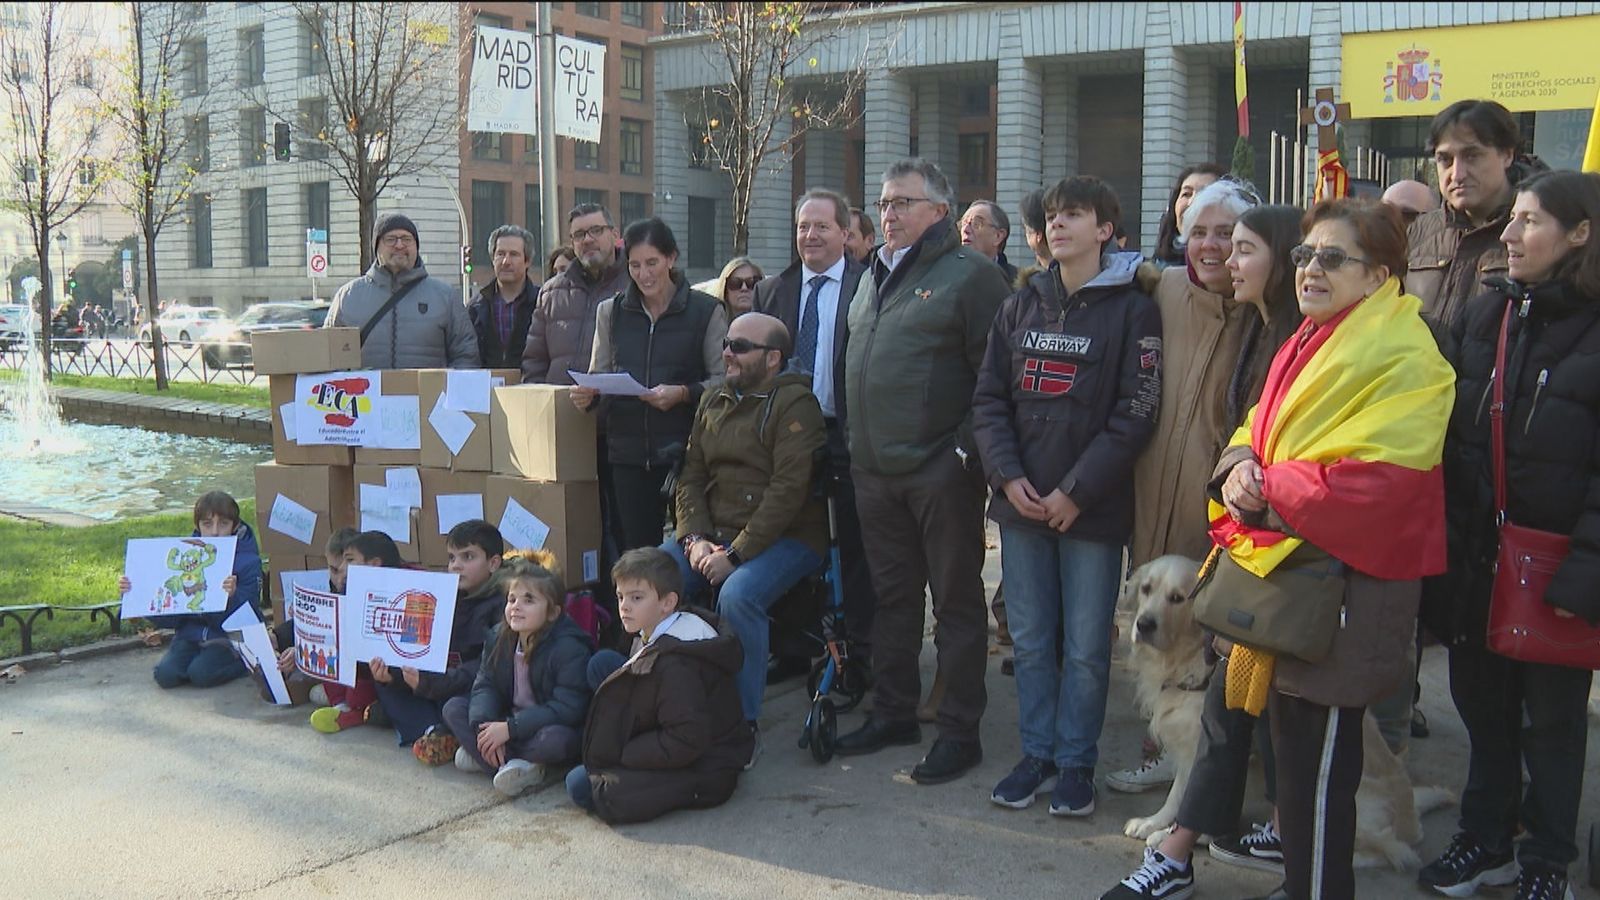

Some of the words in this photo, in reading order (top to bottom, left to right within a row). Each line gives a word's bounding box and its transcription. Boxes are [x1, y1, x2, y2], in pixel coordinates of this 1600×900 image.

[478, 35, 532, 64] MAD
[559, 45, 595, 75] CUL
[497, 64, 532, 90] RID
[564, 71, 588, 97] TU
[1491, 70, 1540, 80] MINISTERIO
[1491, 81, 1503, 90] DE
[1504, 79, 1552, 89] DERECHOS
[1554, 76, 1596, 87] SOCIALES
[1491, 90, 1497, 98] Y
[1499, 89, 1536, 98] AGENDA
[1538, 88, 1558, 97] 2030
[576, 98, 600, 124] RA
[1023, 331, 1086, 352] NORWAY
